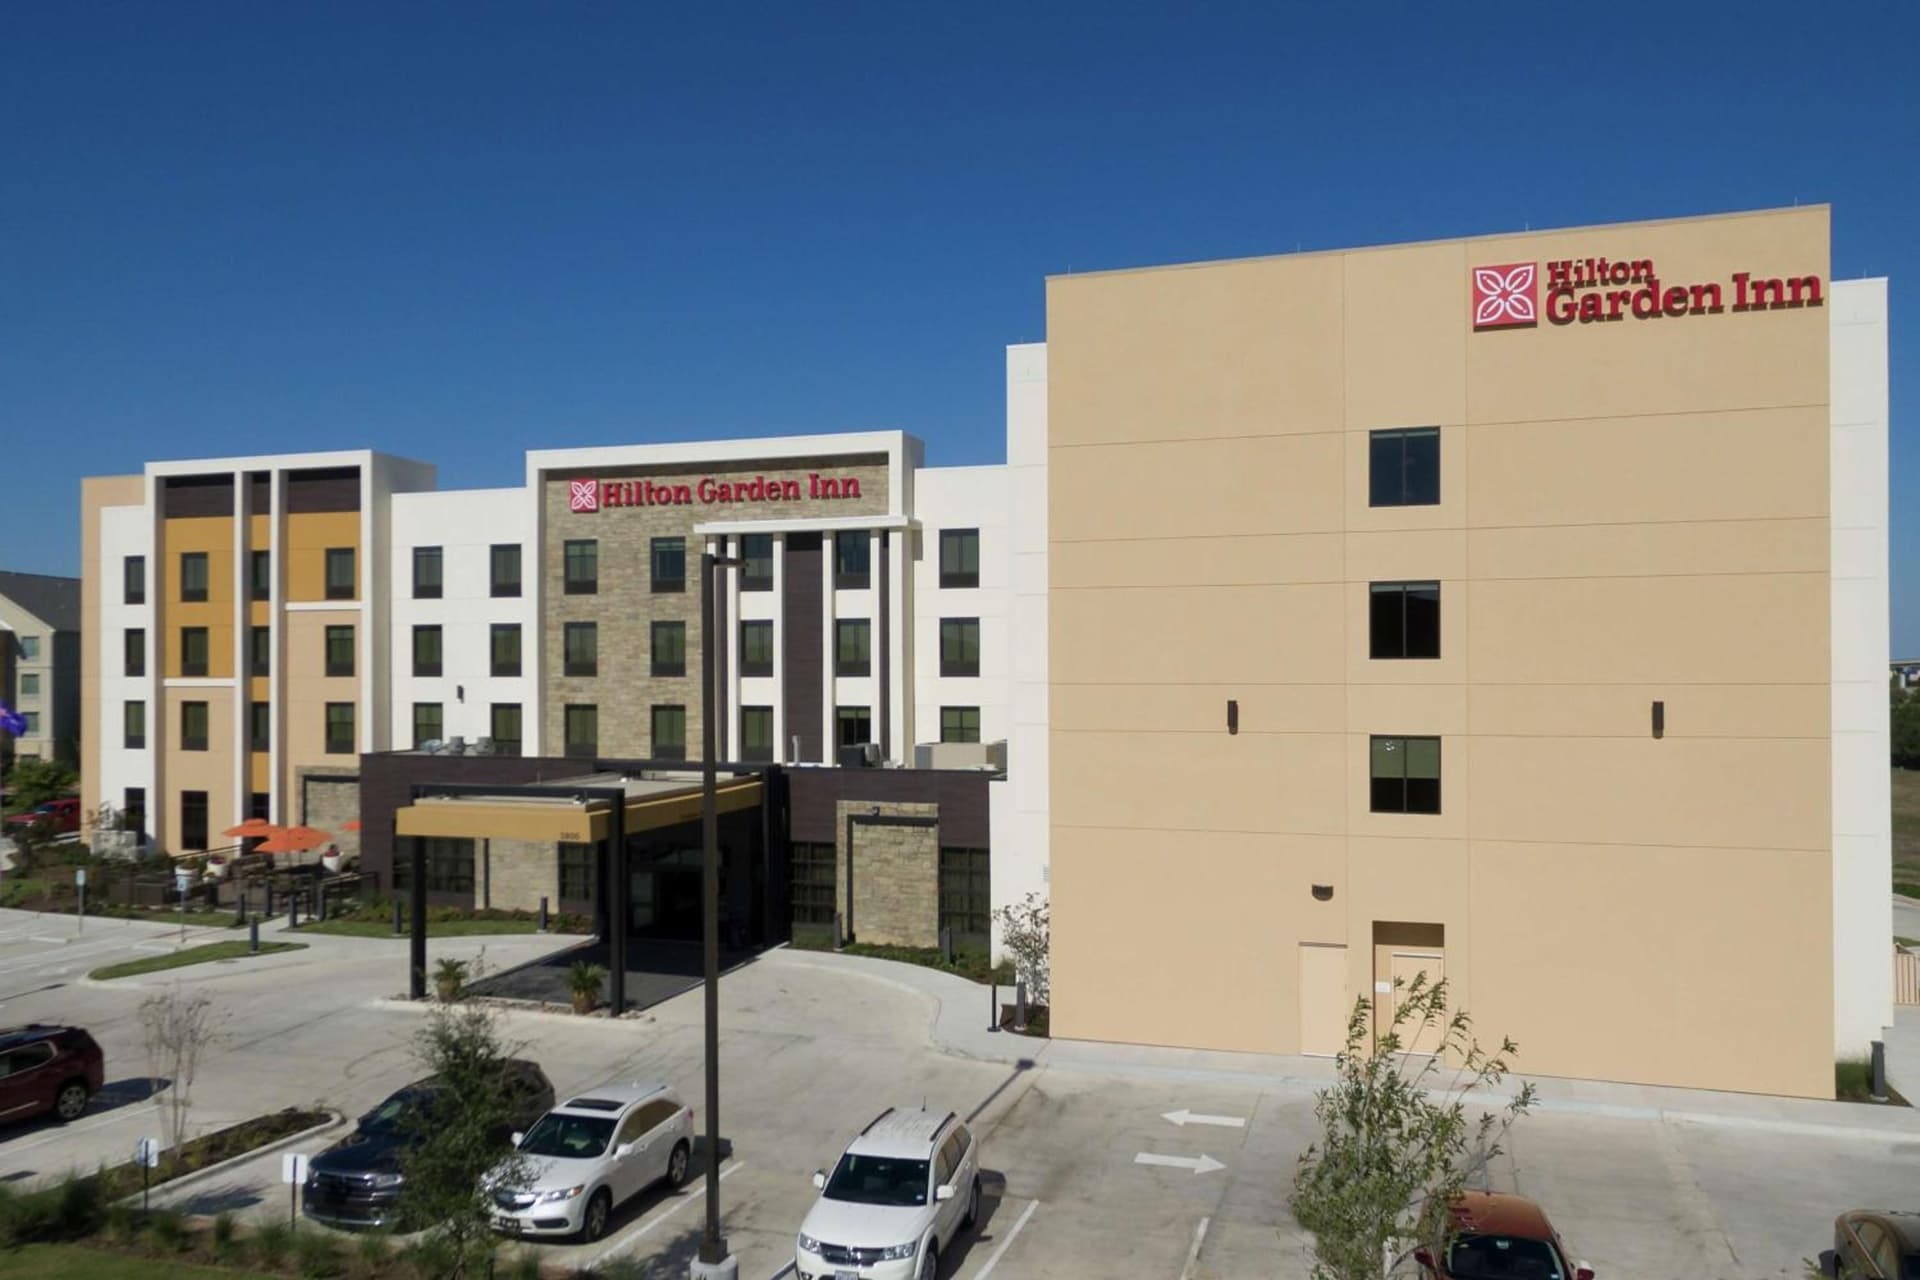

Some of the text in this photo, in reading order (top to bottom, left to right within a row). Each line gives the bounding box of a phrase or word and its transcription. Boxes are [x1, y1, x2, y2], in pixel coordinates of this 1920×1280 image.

[1547, 257, 1655, 288] Hilton
[1545, 271, 1824, 325] Garden Inn
[602, 472, 861, 507] Hilton Garden Inn
